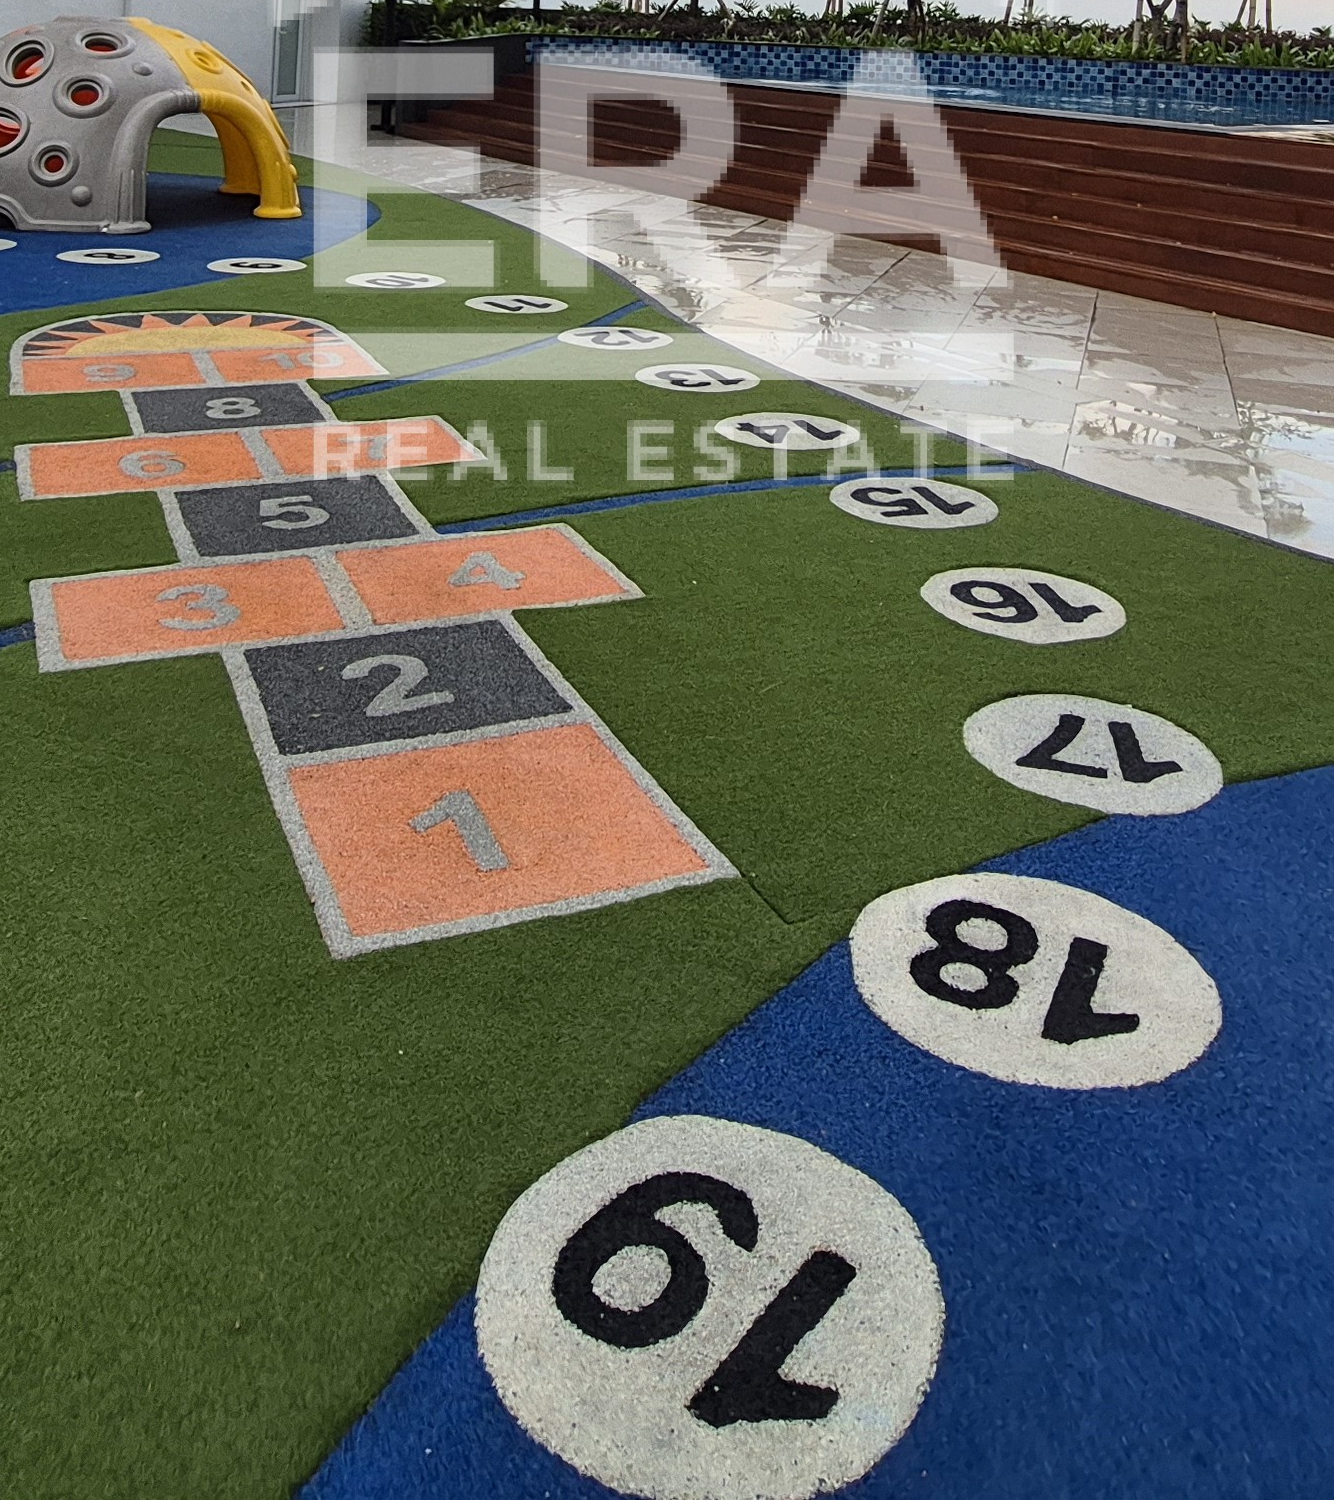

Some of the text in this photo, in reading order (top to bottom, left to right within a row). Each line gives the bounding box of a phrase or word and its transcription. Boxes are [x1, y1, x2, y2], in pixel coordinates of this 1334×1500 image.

[84, 251, 135, 261] 8
[370, 273, 430, 288] 10
[490, 297, 552, 312] 11
[574, 329, 661, 346] 12
[83, 363, 137, 384] 9
[264, 350, 345, 370] 10
[655, 368, 747, 388] 13
[205, 396, 262, 420] 8
[736, 418, 845, 444] 14
[338, 433, 395, 461] 7
[117, 449, 185, 480] 6
[258, 495, 331, 530] 5
[850, 485, 976, 518] 15
[447, 550, 525, 591] 4
[155, 583, 242, 632] 3
[949, 579, 1103, 624] 16
[341, 653, 456, 718] 2
[1015, 713, 1184, 784] 17
[409, 789, 509, 872] 1
[908, 898, 1141, 1046] 18
[551, 1170, 857, 1428] 19
